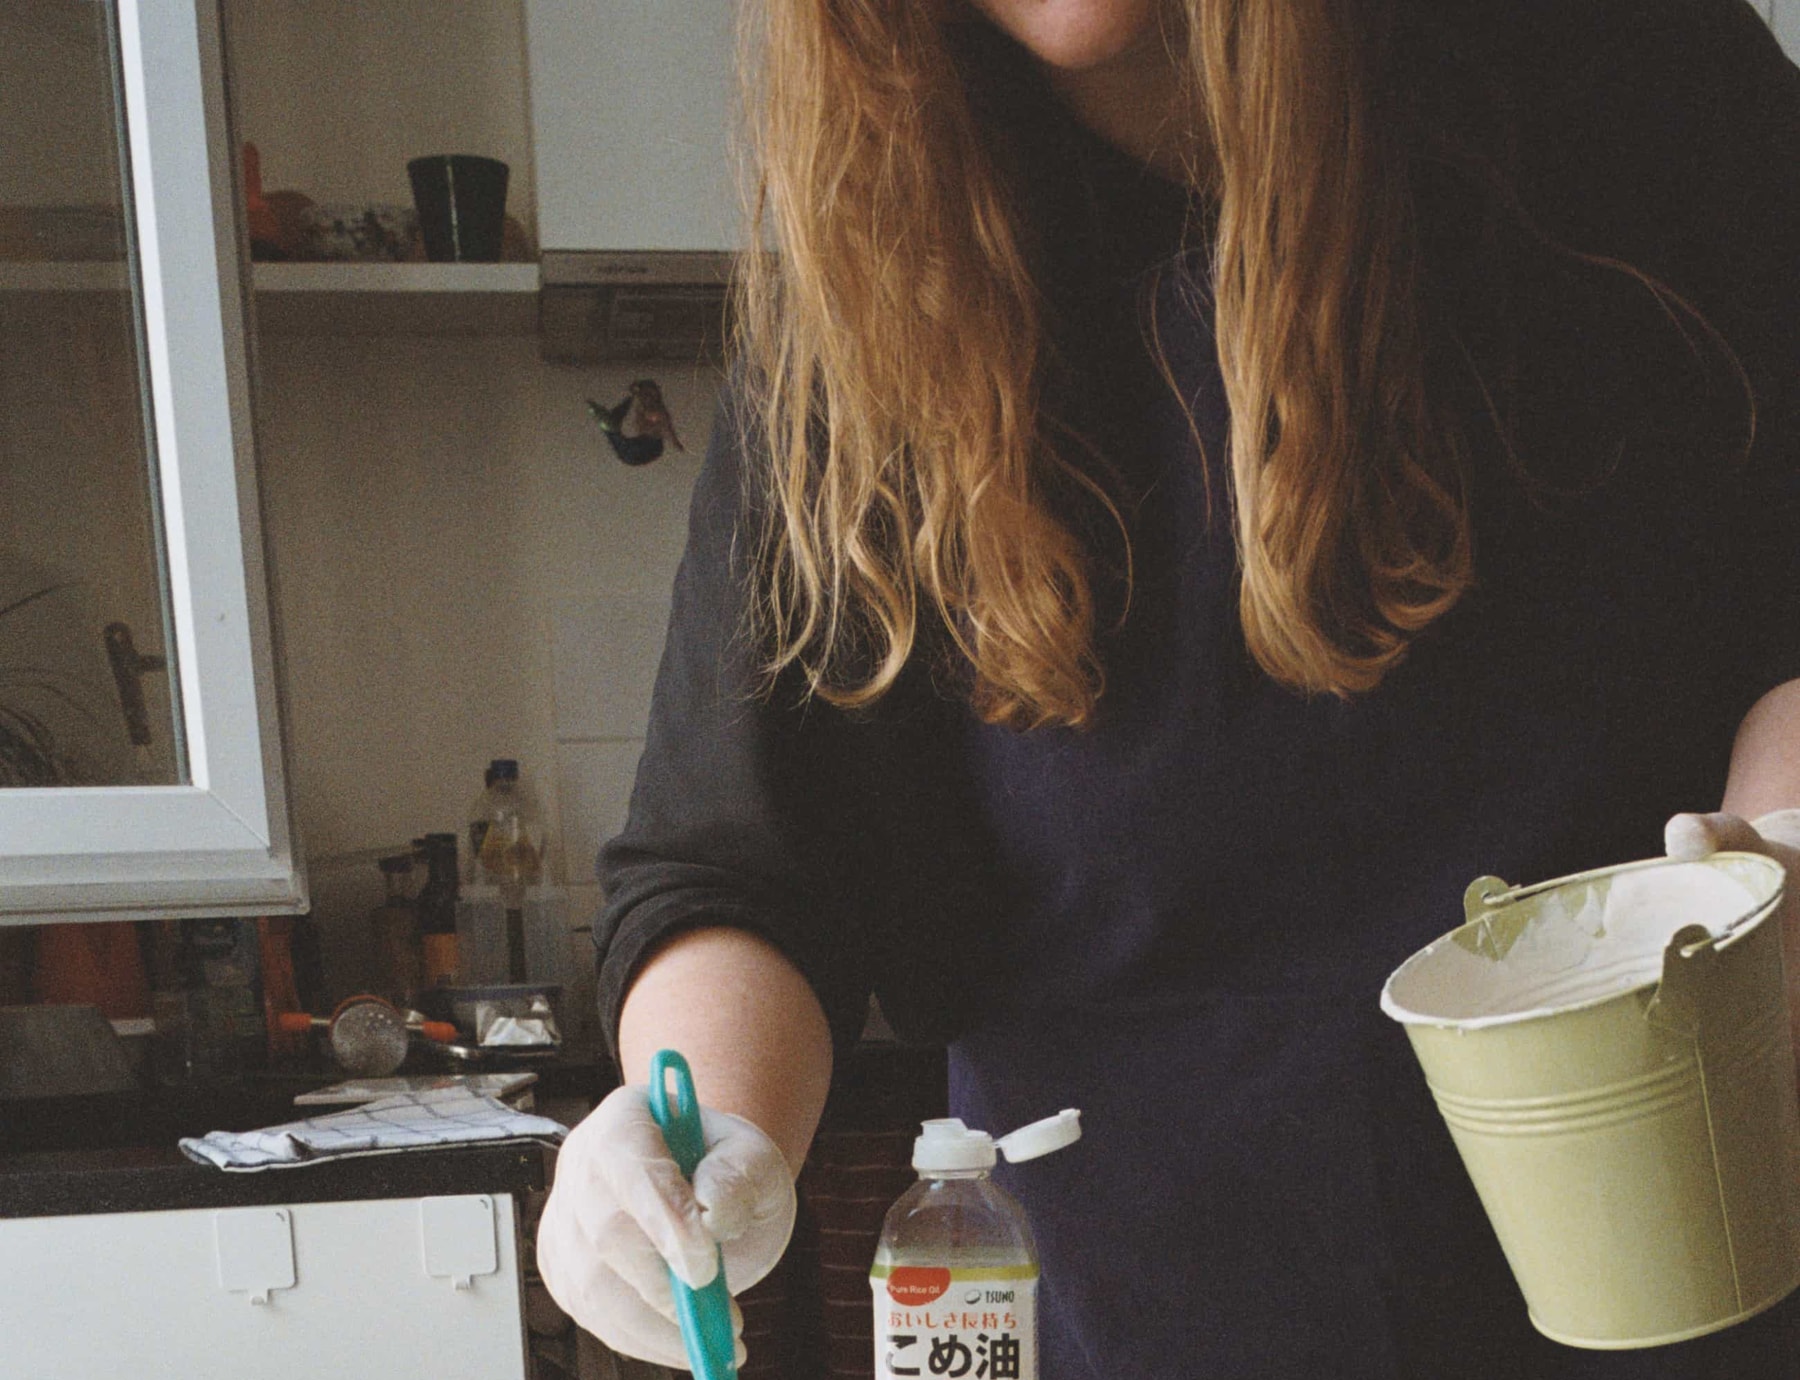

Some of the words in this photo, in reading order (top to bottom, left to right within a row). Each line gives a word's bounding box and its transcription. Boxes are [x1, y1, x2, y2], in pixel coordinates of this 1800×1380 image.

[890, 1285, 909, 1294] Pure
[909, 1284, 927, 1294] Rice
[928, 1284, 941, 1294] Oil
[985, 1290, 1015, 1303] TSUNO
[888, 1312, 1017, 1329] おいしさ長持ち
[886, 1333, 1020, 1380] こめ油
